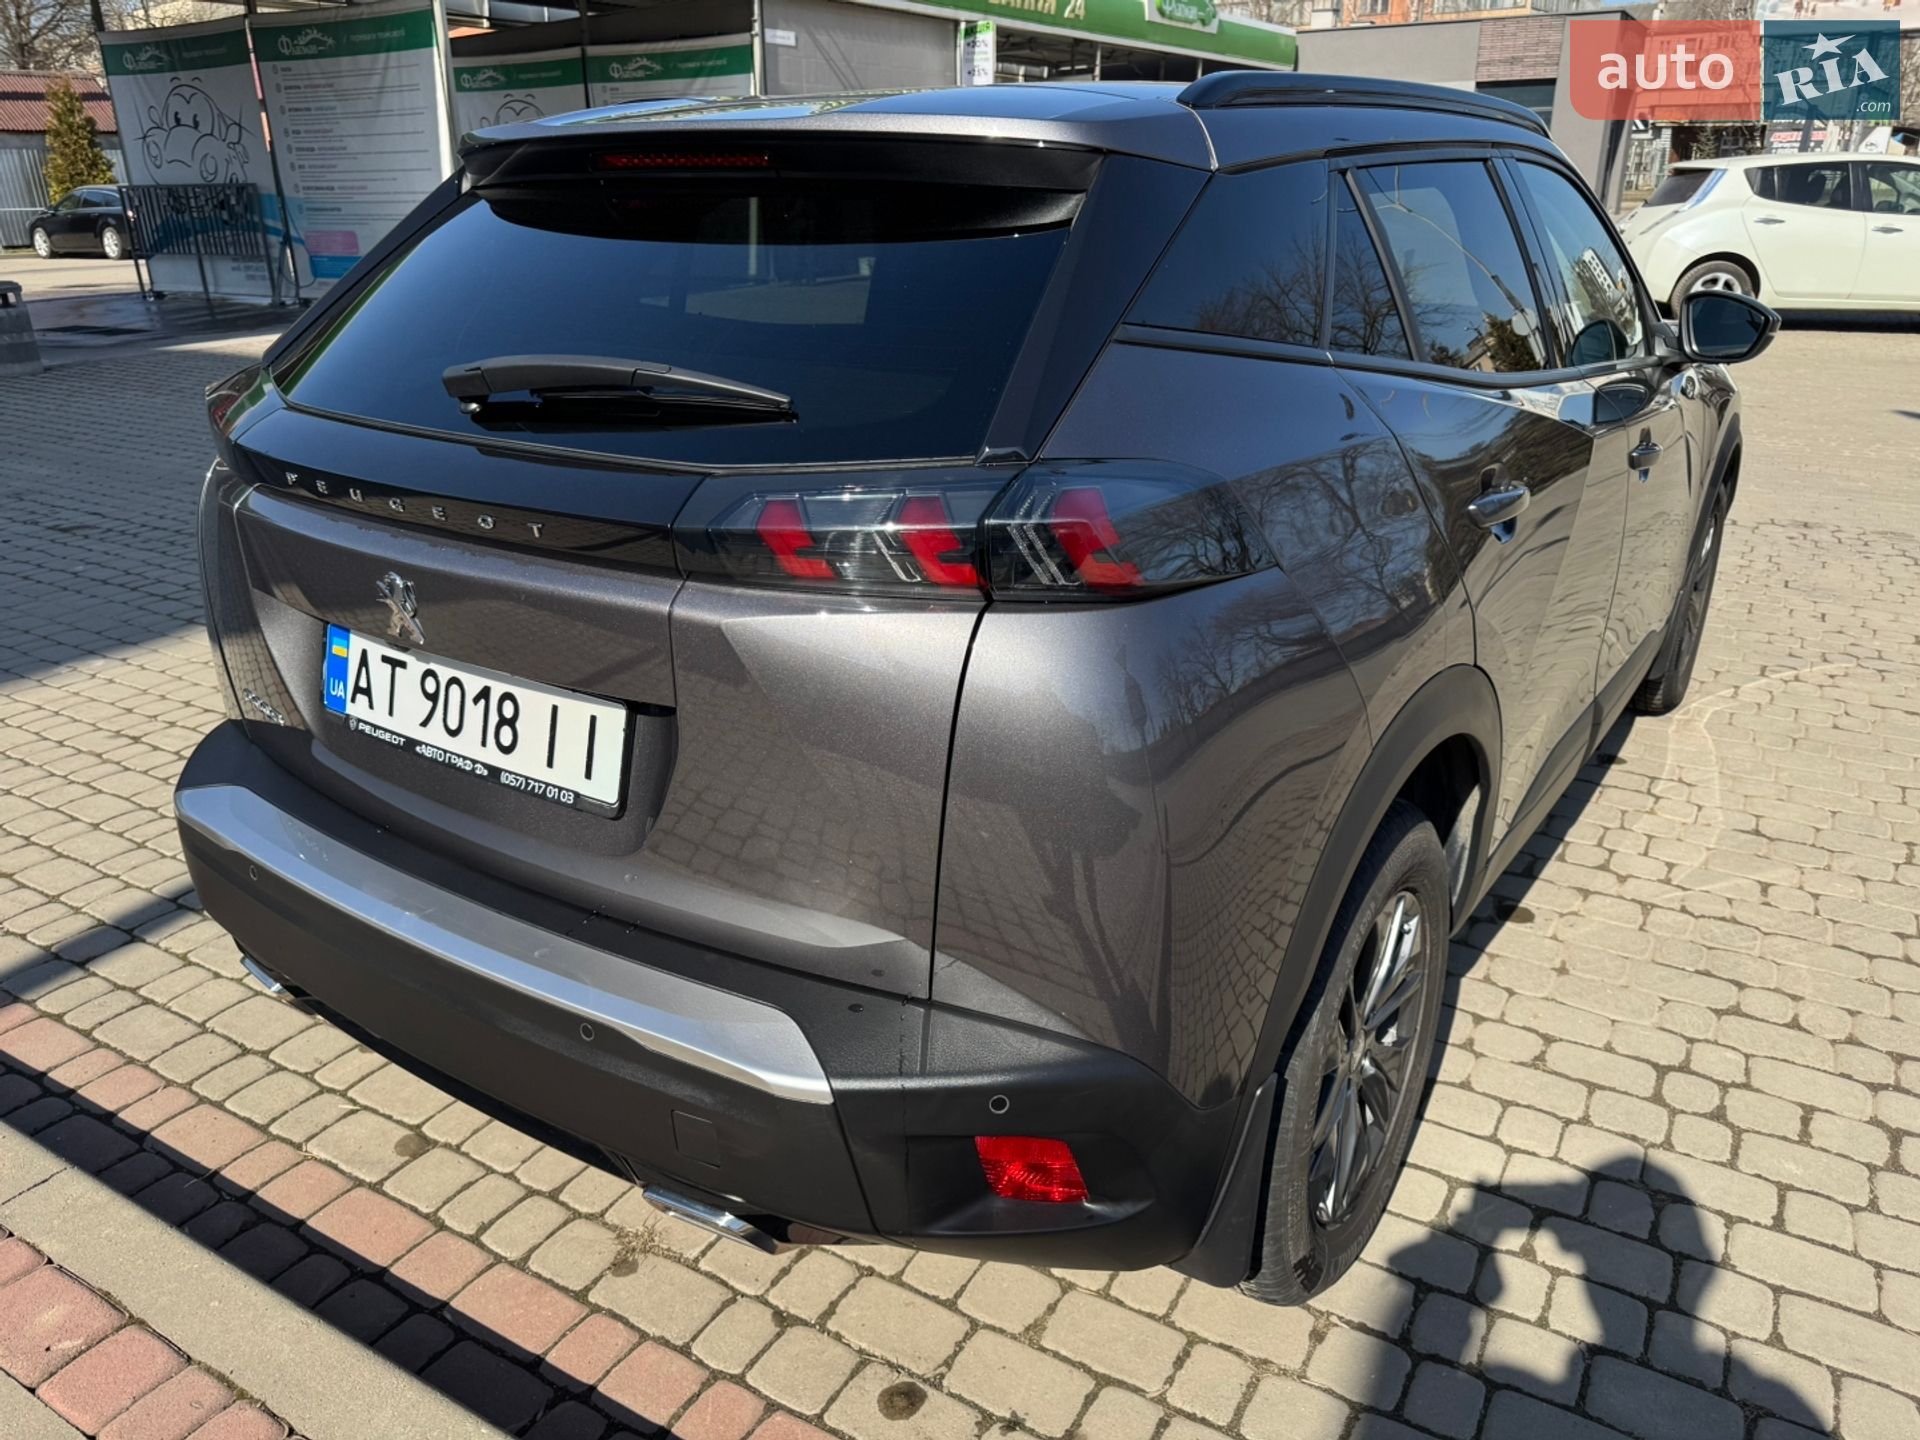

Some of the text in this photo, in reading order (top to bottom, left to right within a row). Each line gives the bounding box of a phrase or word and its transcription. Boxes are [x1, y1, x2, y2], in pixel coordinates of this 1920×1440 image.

[285, 471, 545, 538] PEUGEOT
[329, 677, 346, 700] UA
[350, 648, 408, 718] AT
[419, 668, 520, 756] 9018
[358, 722, 407, 747] PEUGEOT
[500, 770, 574, 804] (057) 717 01 03
